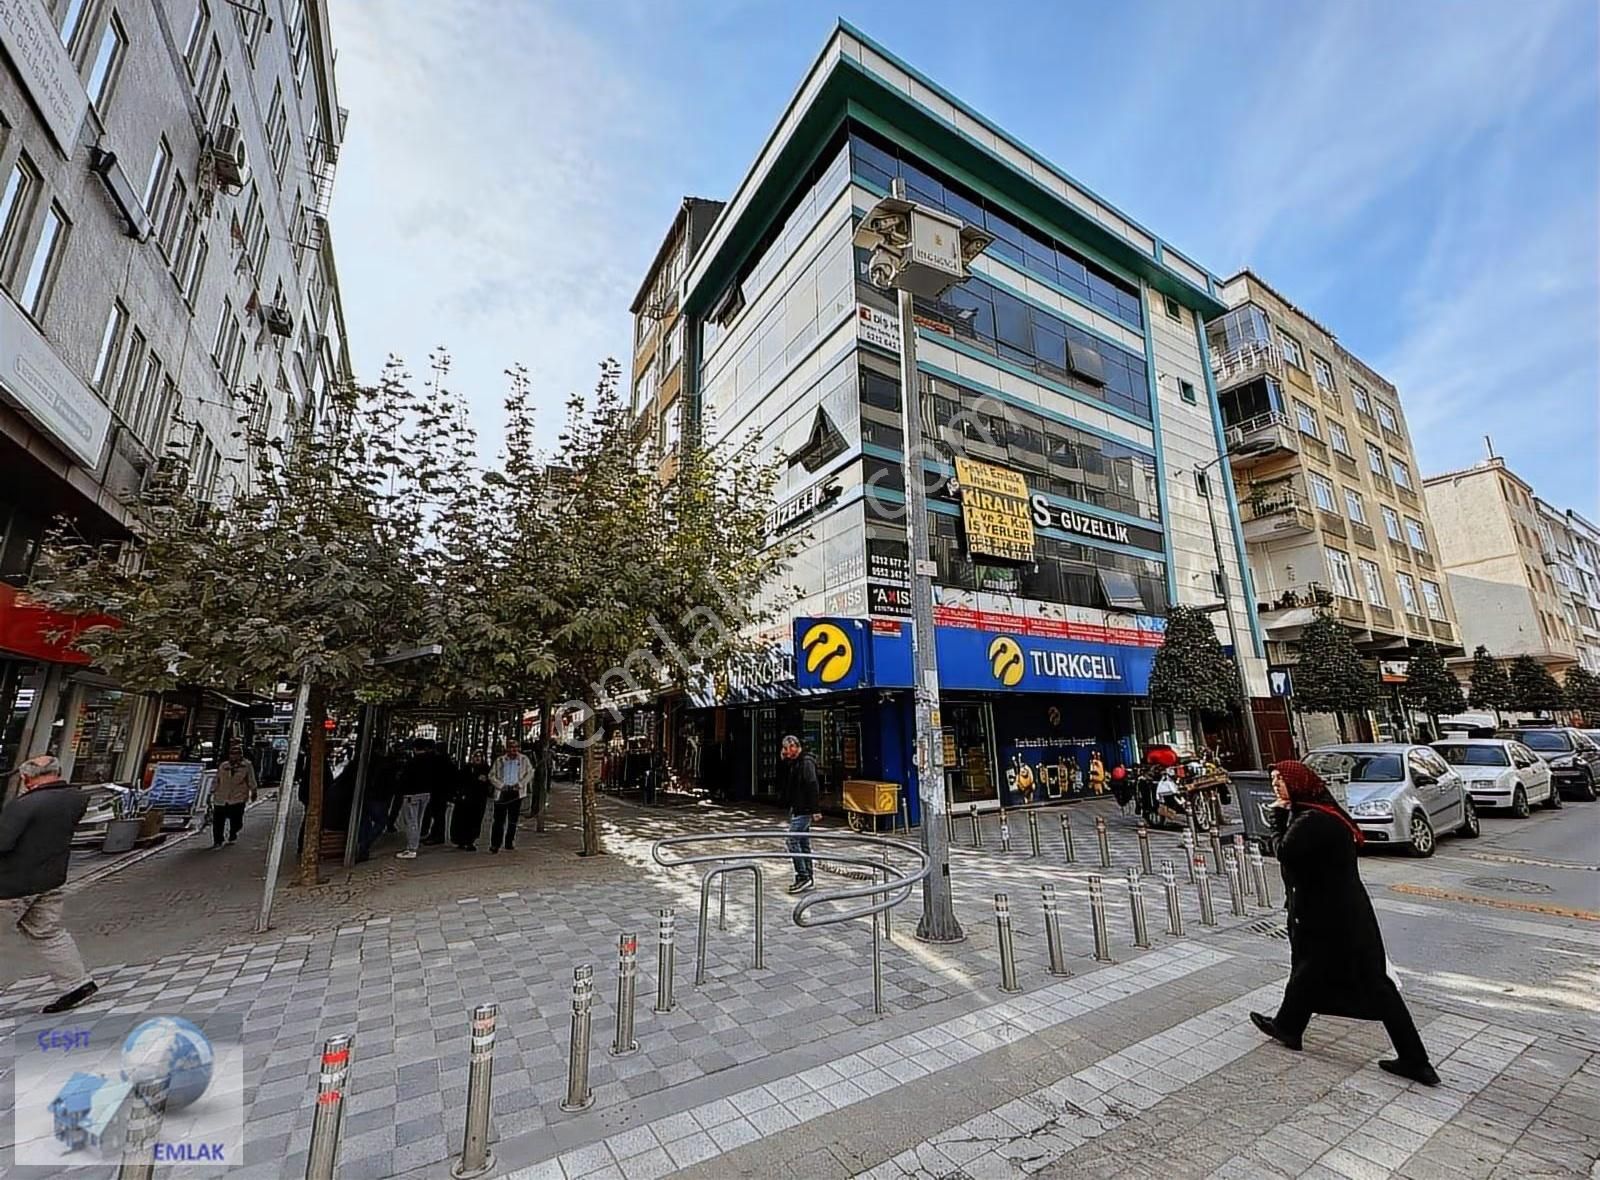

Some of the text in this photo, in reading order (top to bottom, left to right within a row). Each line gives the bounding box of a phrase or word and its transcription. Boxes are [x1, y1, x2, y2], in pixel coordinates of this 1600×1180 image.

[962, 488, 1030, 519] KİRALIK
[1060, 510, 1130, 544] GÜZELLİK
[1030, 650, 1122, 680] TURKCELL
